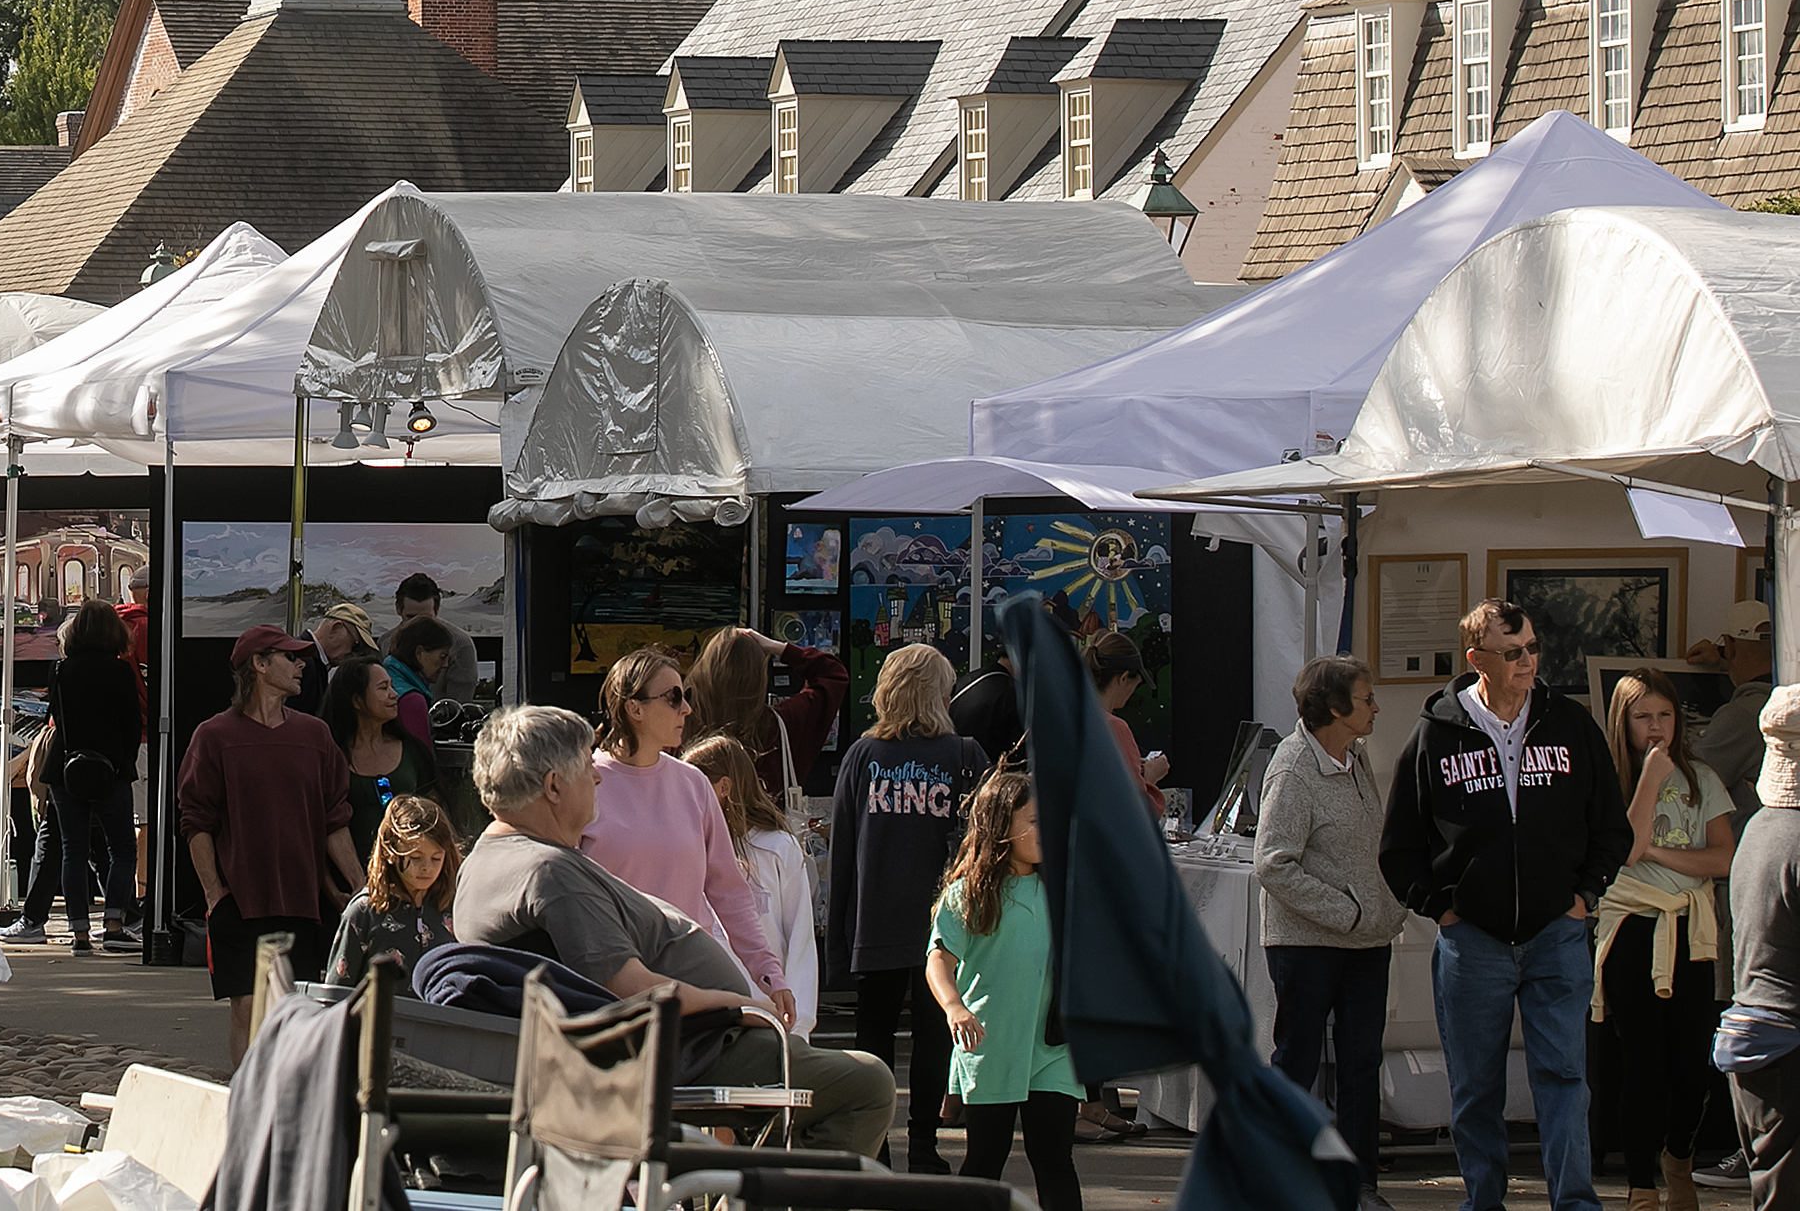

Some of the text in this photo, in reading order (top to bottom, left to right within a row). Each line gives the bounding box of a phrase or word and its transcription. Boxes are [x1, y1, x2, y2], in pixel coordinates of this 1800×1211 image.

[868, 760, 928, 785] Daughter
[1440, 745, 1572, 787] SAINT FANCIS
